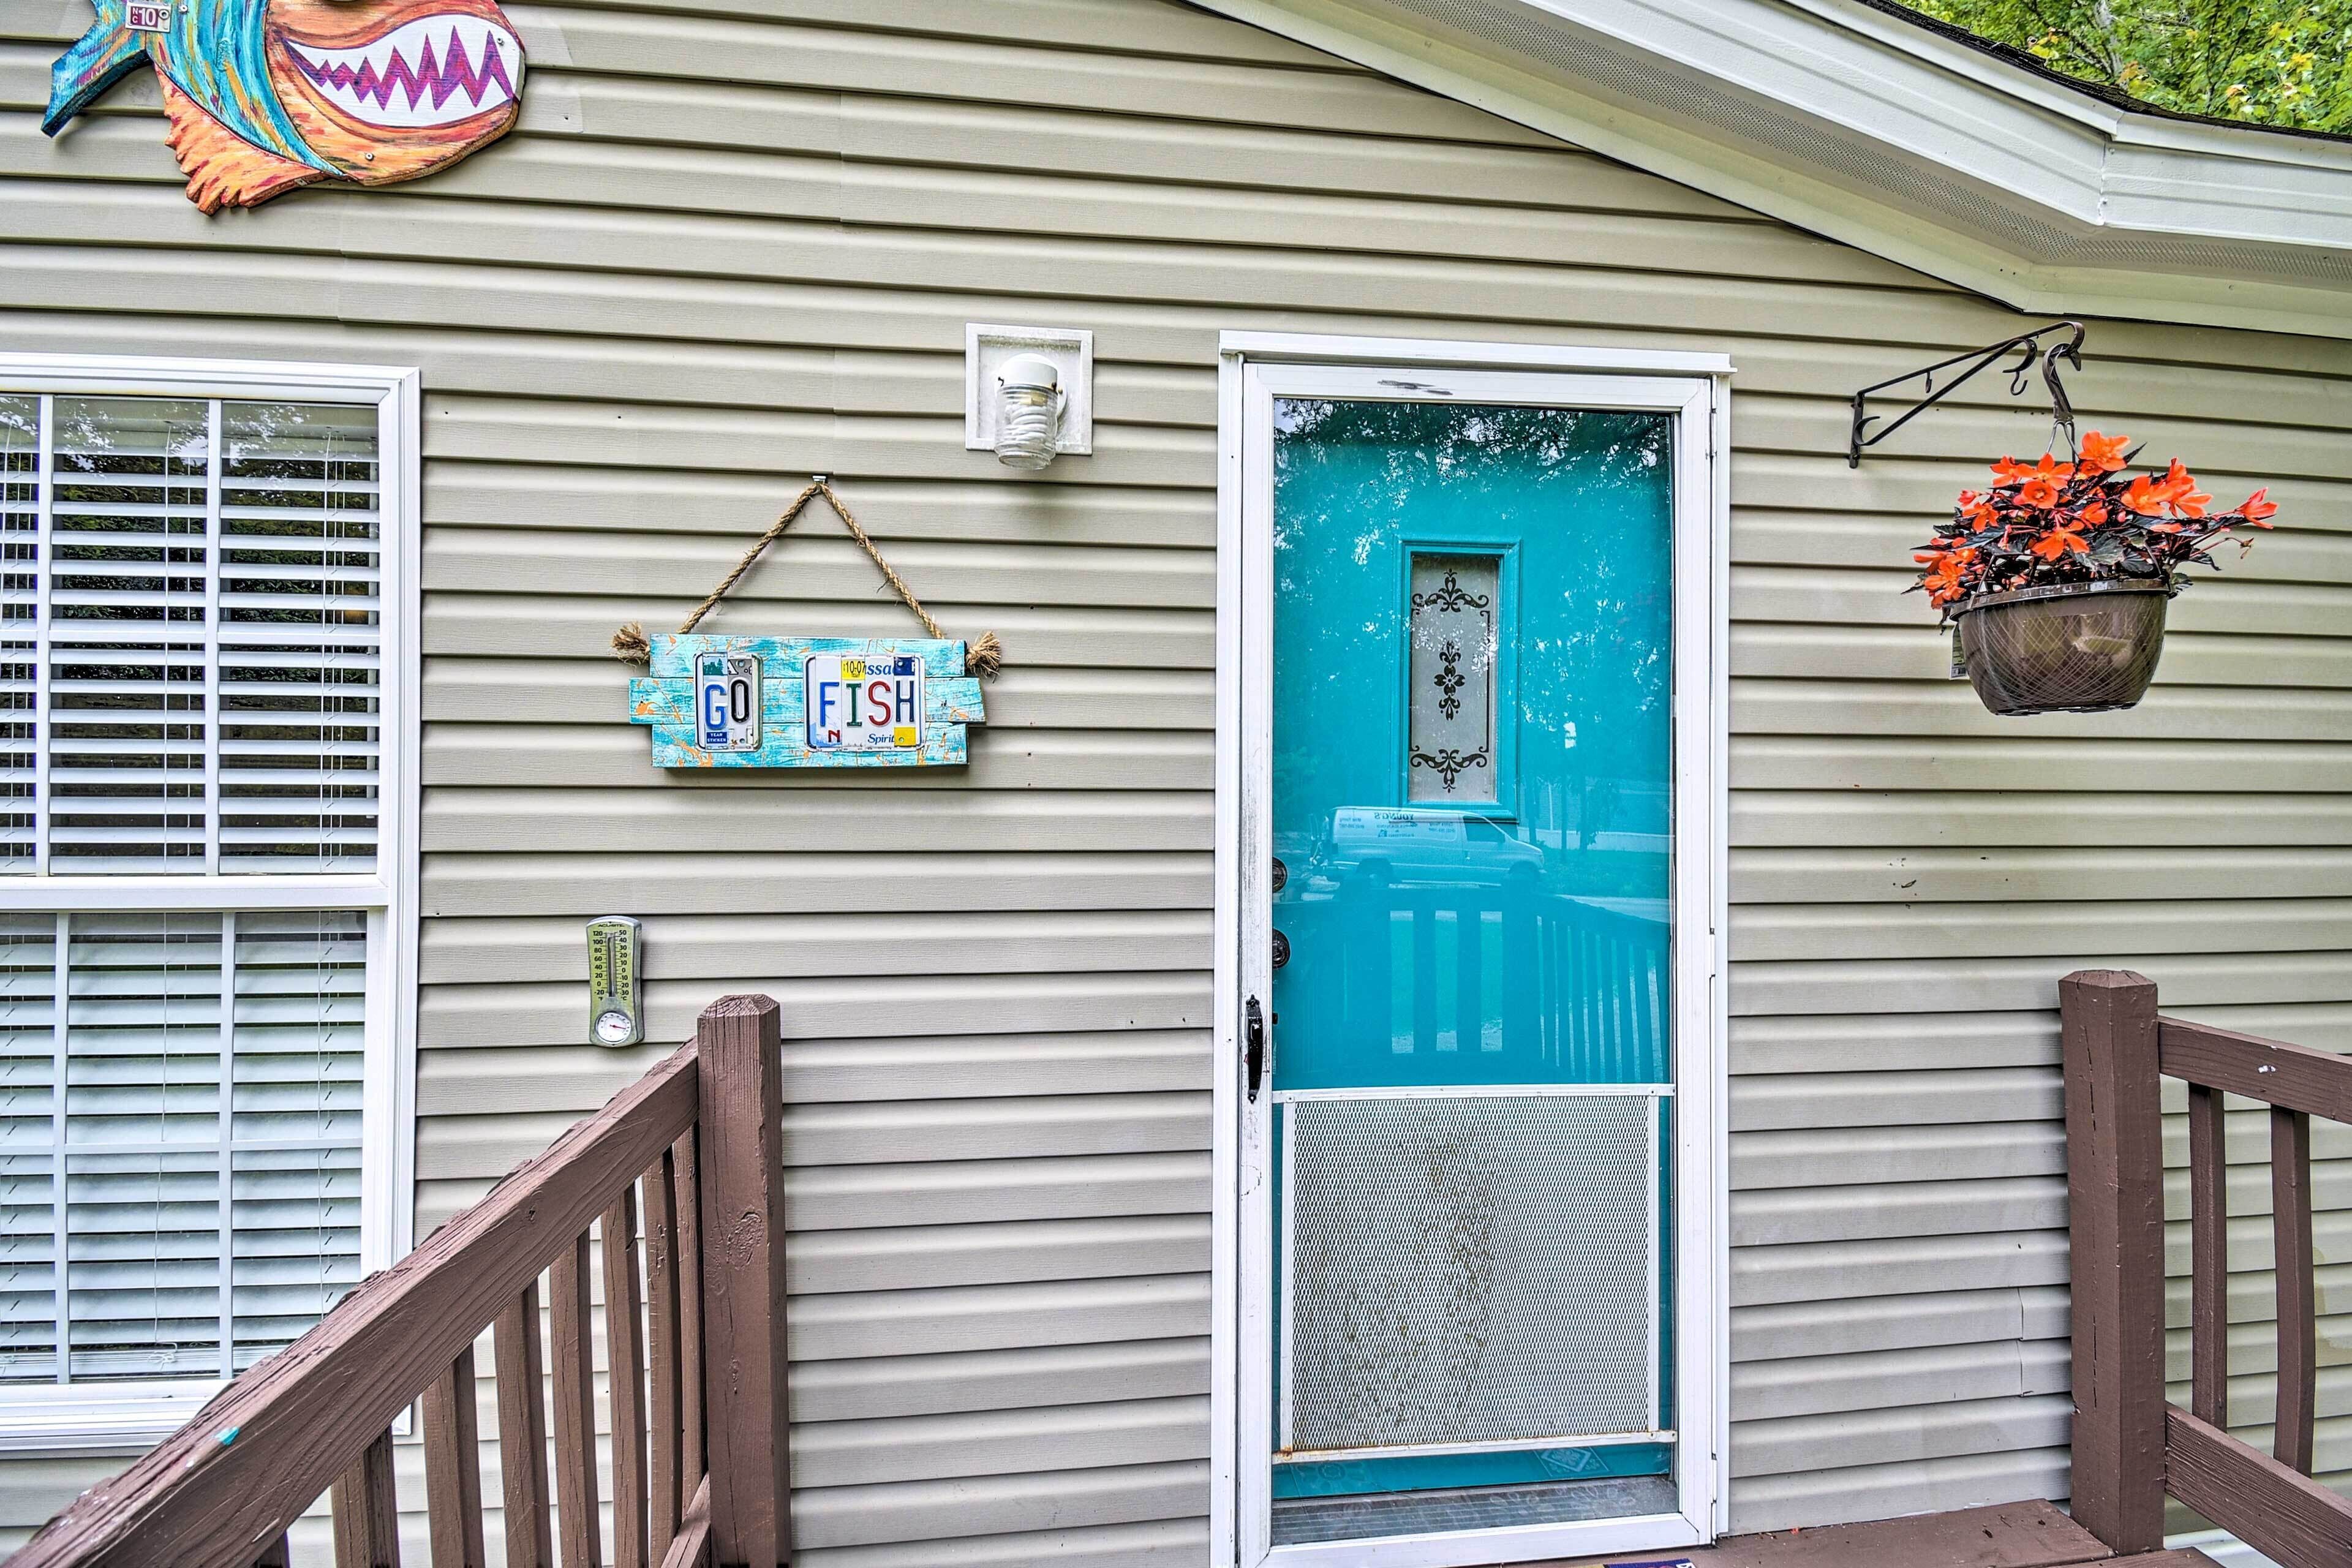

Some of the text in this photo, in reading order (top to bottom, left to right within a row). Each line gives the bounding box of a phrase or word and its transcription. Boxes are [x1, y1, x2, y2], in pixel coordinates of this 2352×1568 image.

[704, 679, 915, 729] GO FISH
[867, 733, 895, 745] Spirit
